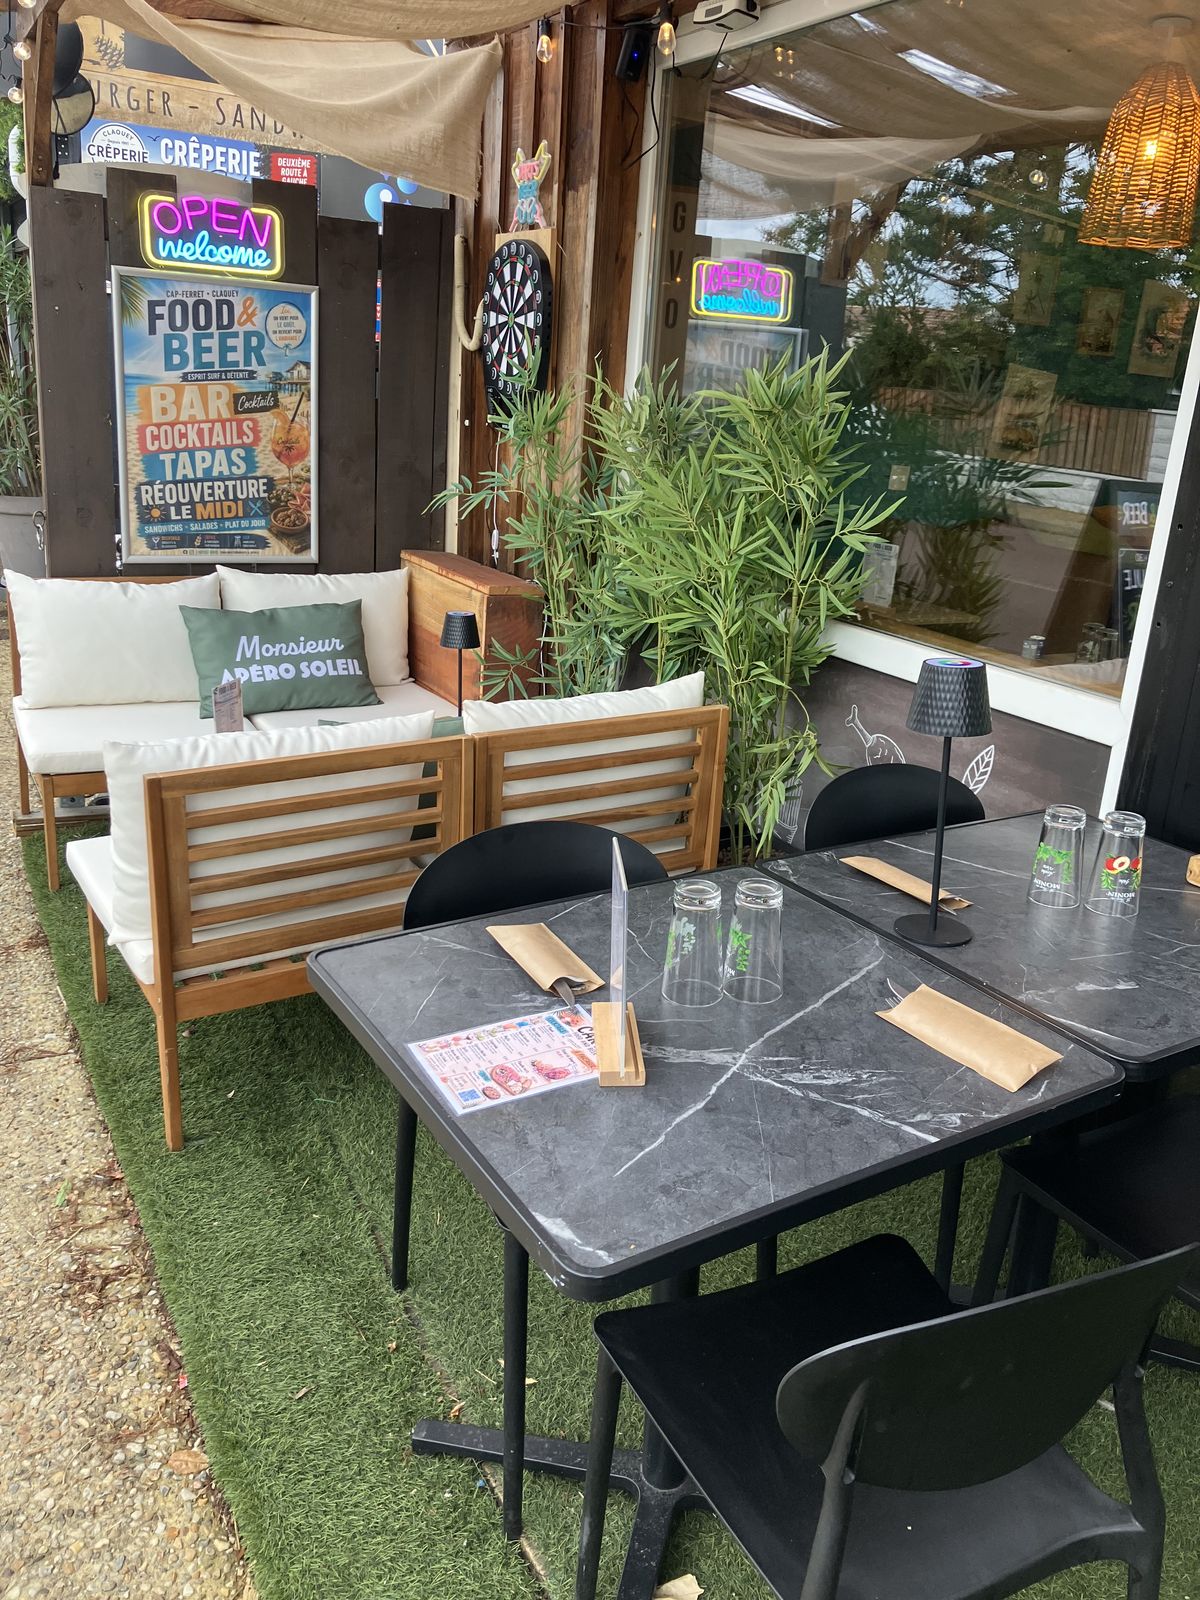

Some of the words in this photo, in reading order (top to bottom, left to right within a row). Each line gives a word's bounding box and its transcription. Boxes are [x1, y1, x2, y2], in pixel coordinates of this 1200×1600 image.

[90, 79, 173, 117] URGER
[216, 97, 303, 139] SAND
[102, 128, 134, 141] CLAQUEY
[87, 143, 149, 163] CRÊPERIE
[159, 136, 261, 177] CRÊPERIE
[278, 157, 311, 168] DEUXIÈME
[281, 167, 300, 177] ROUTE
[302, 167, 308, 177] À
[153, 196, 272, 247] OPEN
[158, 230, 271, 268] welcome
[166, 290, 204, 298] CAP-FERRET
[212, 290, 239, 298] CLAQUEY
[147, 299, 235, 336] FOOD
[236, 296, 258, 328] &
[163, 330, 267, 372] BEER
[187, 372, 206, 381] ESPRIT
[207, 372, 221, 380] SURF
[226, 371, 249, 379] DÉTENTE
[150, 385, 231, 423] BAR
[237, 393, 274, 411] Cocktails
[145, 421, 254, 451] COCKTAILS
[159, 448, 247, 480] TAPAS
[140, 478, 268, 506] RÉOUVERTURE
[169, 505, 193, 520] LE
[195, 500, 244, 520] MIDI
[190, 522, 218, 531] SALADES
[250, 519, 266, 527] JOUR
[235, 635, 345, 662] Monsieur
[221, 662, 297, 685] APÉRO
[299, 658, 363, 678] SOLEIL
